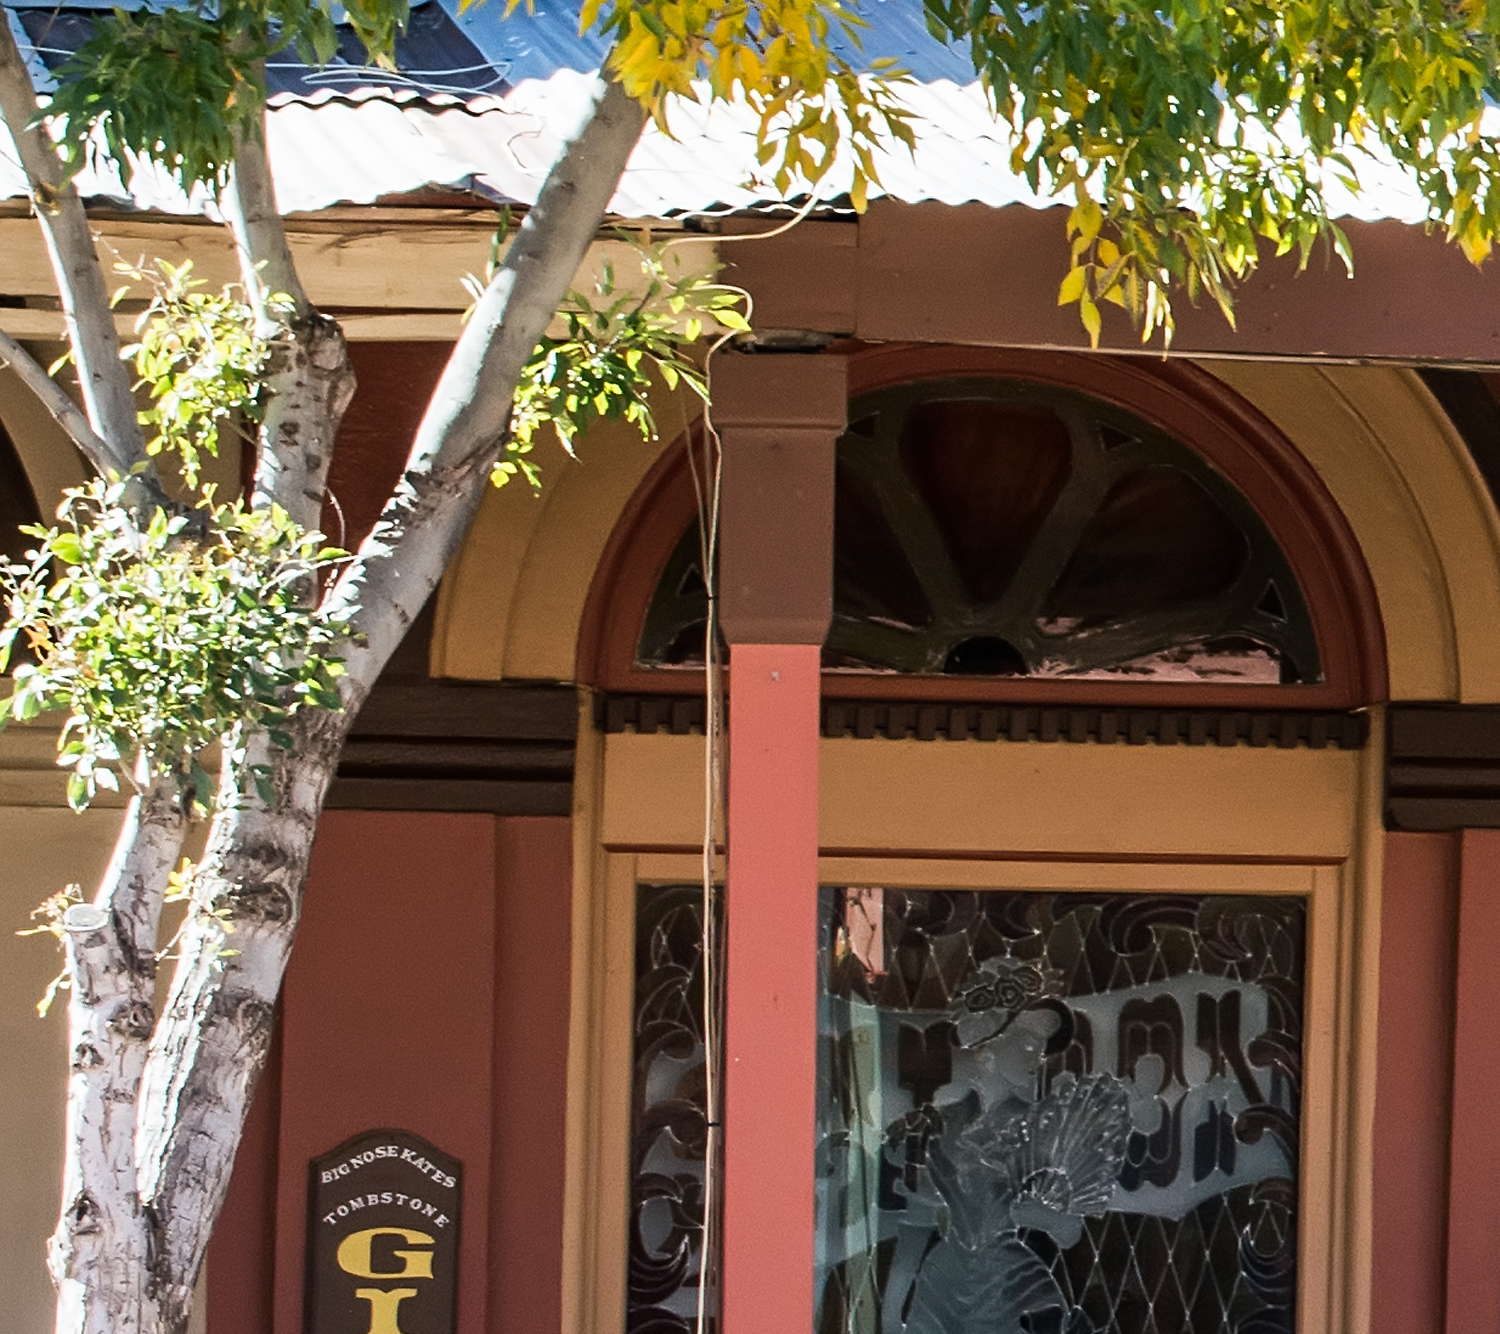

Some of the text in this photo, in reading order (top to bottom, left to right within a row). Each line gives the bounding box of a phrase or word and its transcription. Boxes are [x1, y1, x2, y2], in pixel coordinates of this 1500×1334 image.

[321, 1144, 457, 1189] BIG NOSE KATES
[322, 1191, 451, 1228] TOMBSTONE
